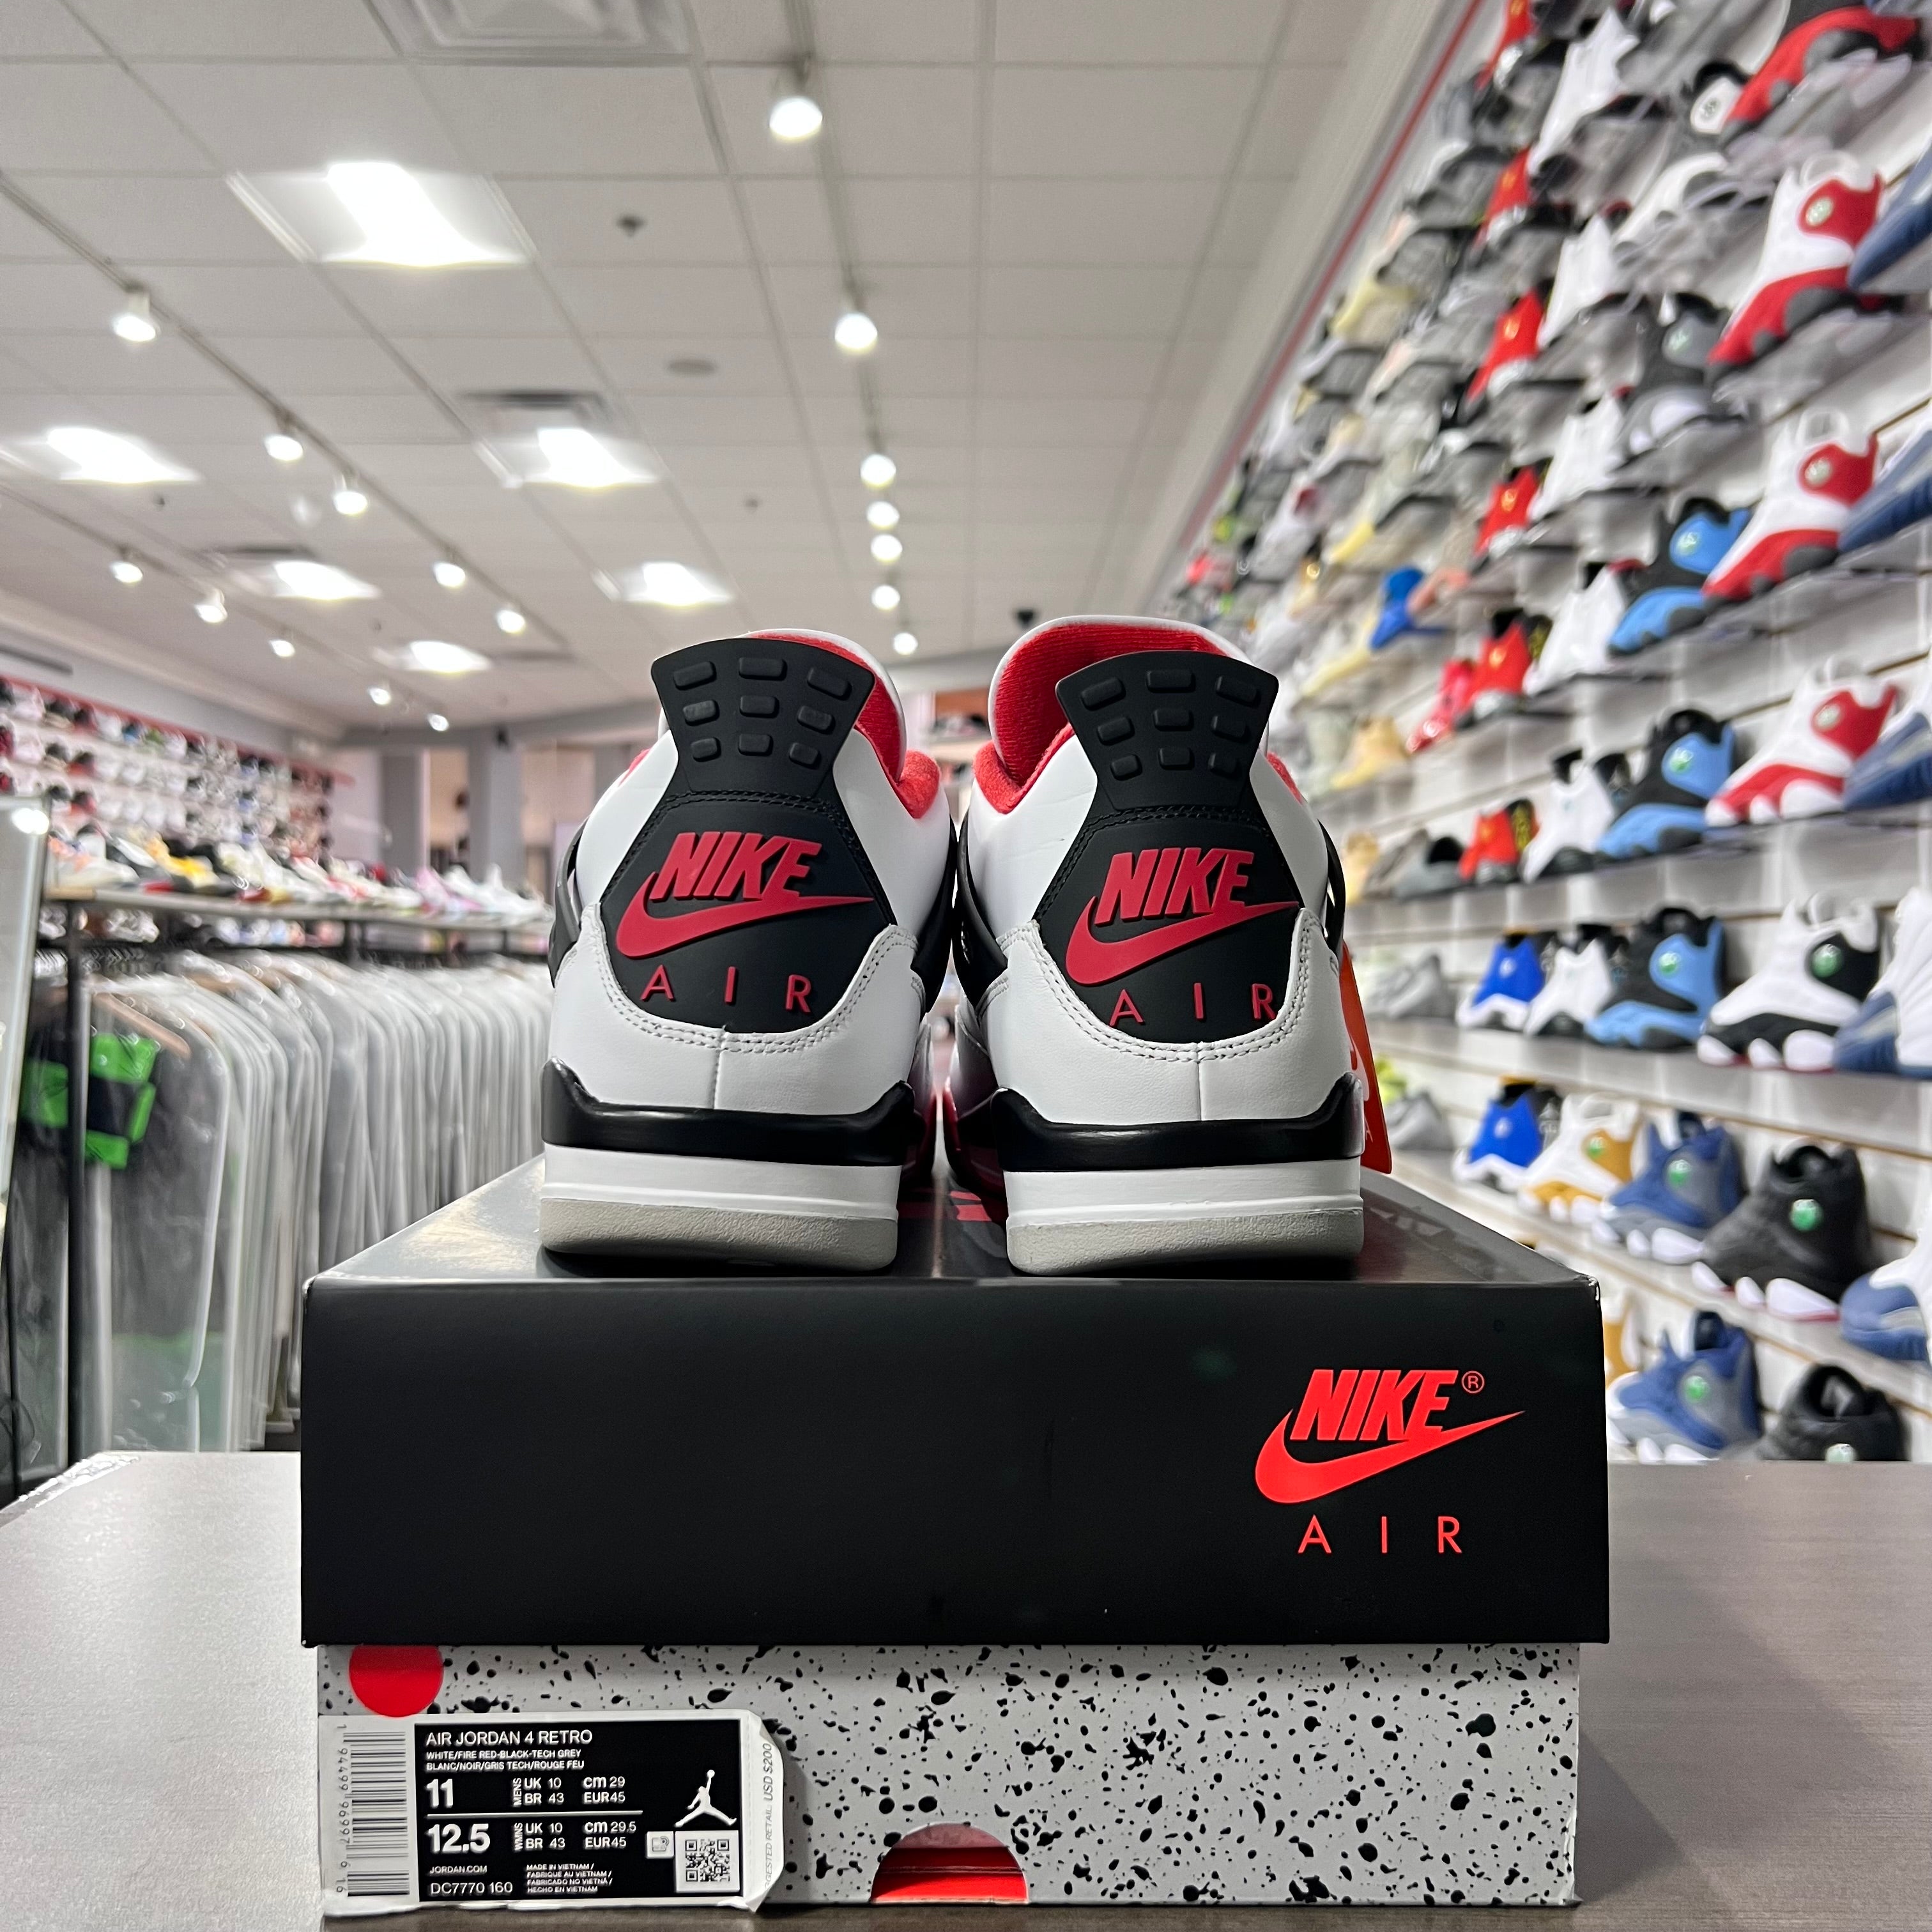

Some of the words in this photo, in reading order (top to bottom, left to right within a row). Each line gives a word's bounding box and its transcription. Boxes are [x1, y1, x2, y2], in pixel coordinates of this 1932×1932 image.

[648, 831, 823, 901] NIKE
[1094, 847, 1255, 925] NIKE
[641, 965, 812, 1013] AIR
[1109, 983, 1277, 1027] AIR
[1290, 1369, 1459, 1441] NIKE
[1298, 1514, 1462, 1553] AIR
[426, 1732, 452, 1746] AIR
[456, 1731, 520, 1745] JORDAN
[524, 1731, 534, 1744] 4
[539, 1729, 593, 1744] RETRO
[426, 1751, 477, 1759] WHITE/FIRE
[479, 1750, 555, 1758] RED-BLACK-TECH
[558, 1749, 581, 1758] GREY
[426, 1762, 504, 1771] BLANC/NOIR/GRIS
[507, 1761, 565, 1770] TECH/ROUGE
[567, 1761, 585, 1769] FEU
[338, 1748, 349, 1790] 94499
[427, 1779, 454, 1807] 11
[513, 1777, 522, 1807] MENS
[524, 1778, 541, 1789] UK
[548, 1777, 562, 1788] 10
[583, 1777, 607, 1789] cm
[610, 1776, 625, 1788] 29
[763, 1776, 773, 1801] USD
[525, 1793, 542, 1804] BR
[548, 1793, 564, 1804] 43
[339, 1802, 350, 1844] 96997
[525, 1823, 543, 1834] UK
[549, 1822, 563, 1833] 10
[584, 1821, 608, 1834] cm
[611, 1821, 636, 1832] 29.5
[427, 1823, 491, 1852] 12.5
[514, 1822, 523, 1851] WMNS
[525, 1838, 543, 1849] BR
[549, 1837, 565, 1848] 43
[430, 1865, 487, 1875] JORDAN.COM
[431, 1882, 485, 1894] DC7770
[489, 1882, 513, 1894] 160
